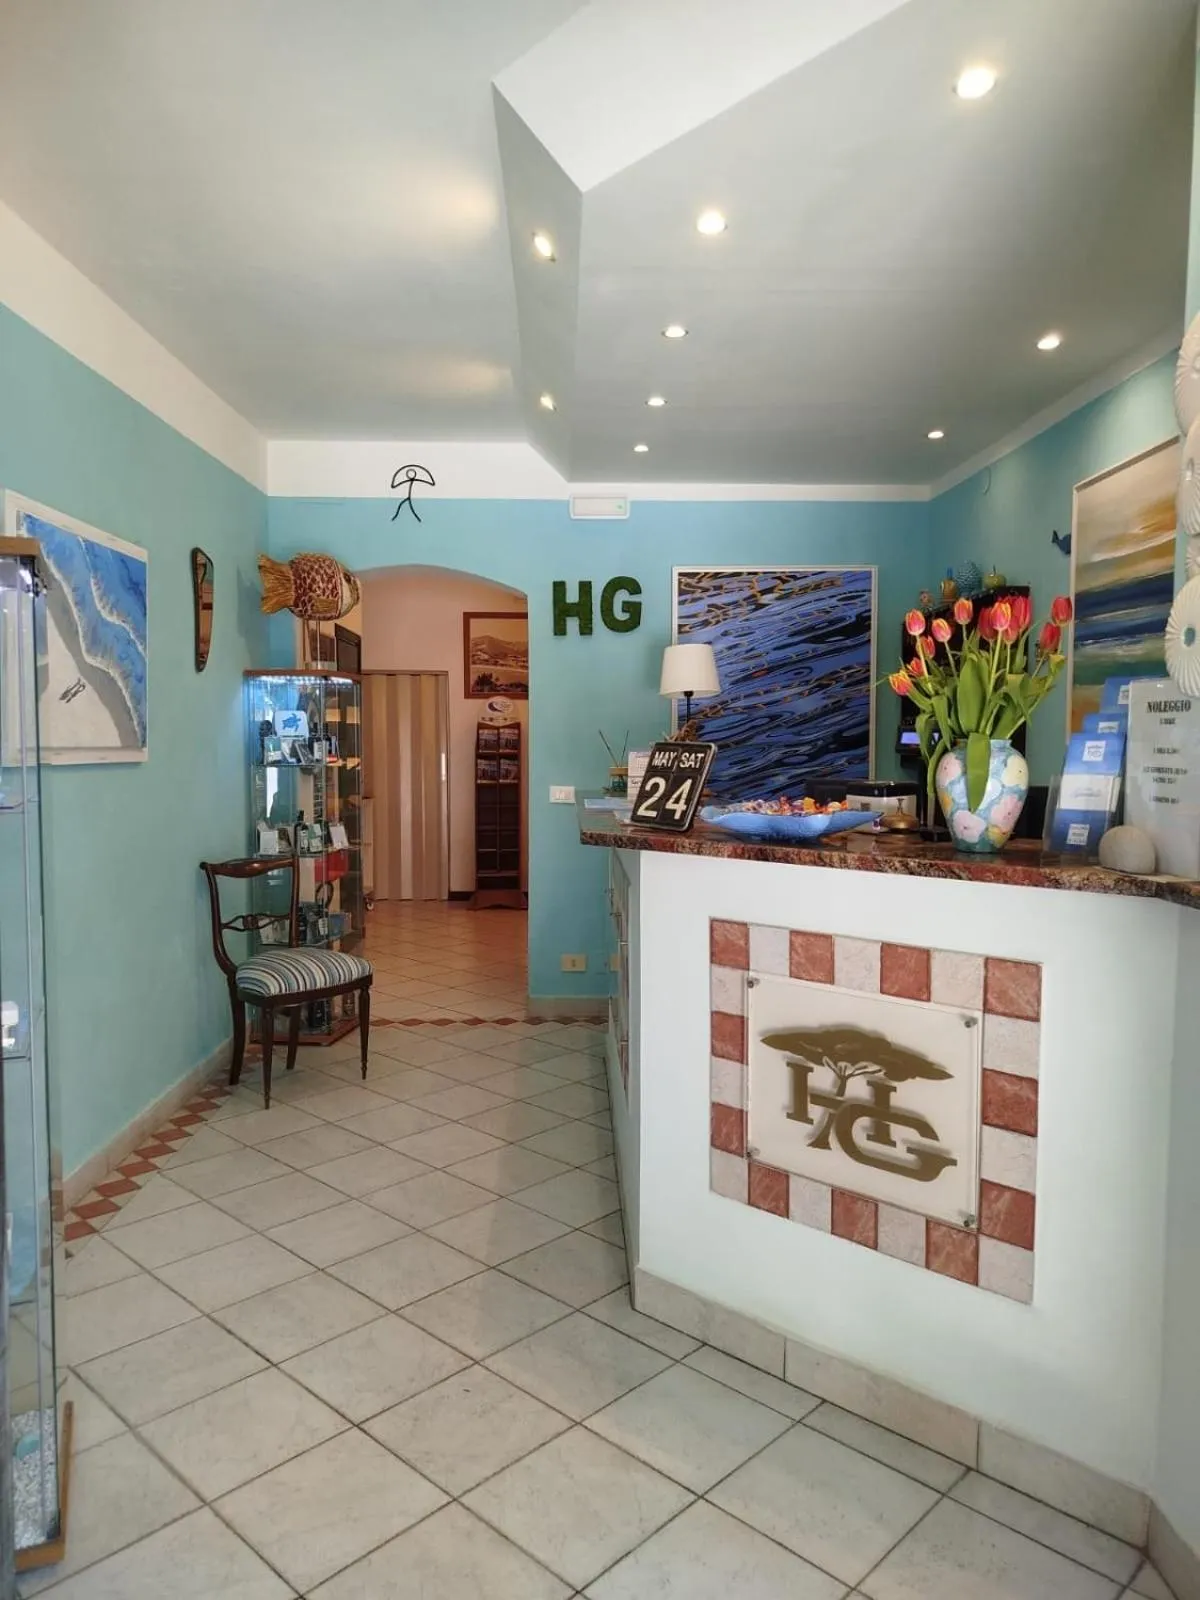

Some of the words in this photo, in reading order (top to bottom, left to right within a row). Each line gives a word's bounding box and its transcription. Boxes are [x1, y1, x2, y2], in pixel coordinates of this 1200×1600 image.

[552, 576, 642, 637] HG
[1147, 700, 1192, 713] NOLEGGIO
[652, 751, 677, 768] MAY
[679, 752, 705, 769] SAT
[637, 776, 693, 820] 24
